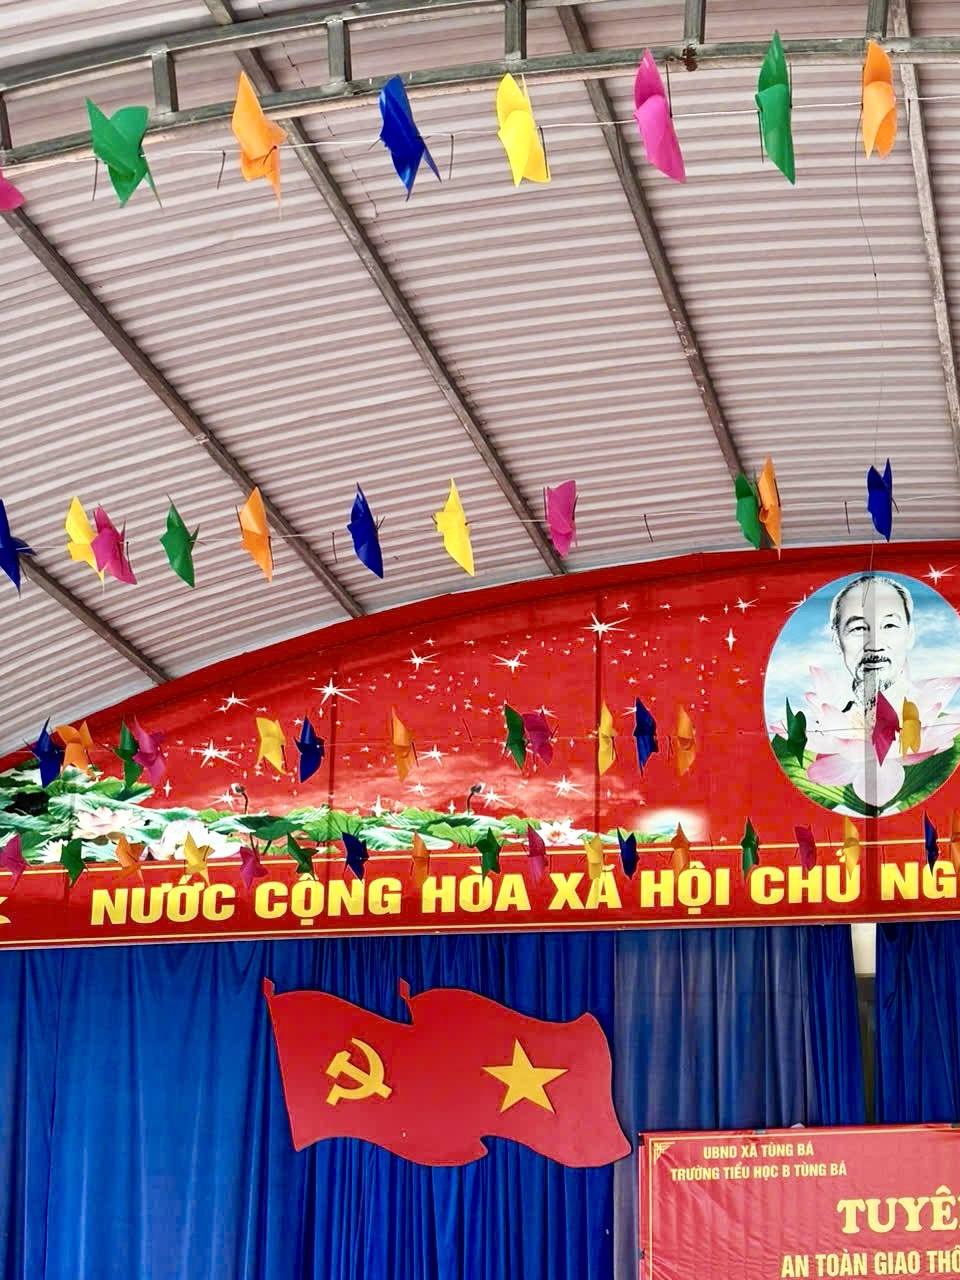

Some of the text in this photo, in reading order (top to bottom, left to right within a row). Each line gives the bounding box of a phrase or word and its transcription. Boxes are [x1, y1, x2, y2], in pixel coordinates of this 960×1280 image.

[91, 875, 235, 925] NƯỚC
[255, 873, 402, 925] CỘNG
[422, 866, 531, 913] HÒA
[548, 864, 622, 910] XÃ
[640, 861, 730, 914] HỘI
[750, 848, 860, 905] CHỦ
[704, 1140, 814, 1159] UBND XÃ TÙNG BÁ
[671, 1160, 847, 1181] TRƯỜNG TIỂU HỌC B TÙNG BÁ
[781, 1255, 809, 1278] AN
[815, 1249, 867, 1276] TOÀN
[874, 1252, 920, 1275] GIAO
